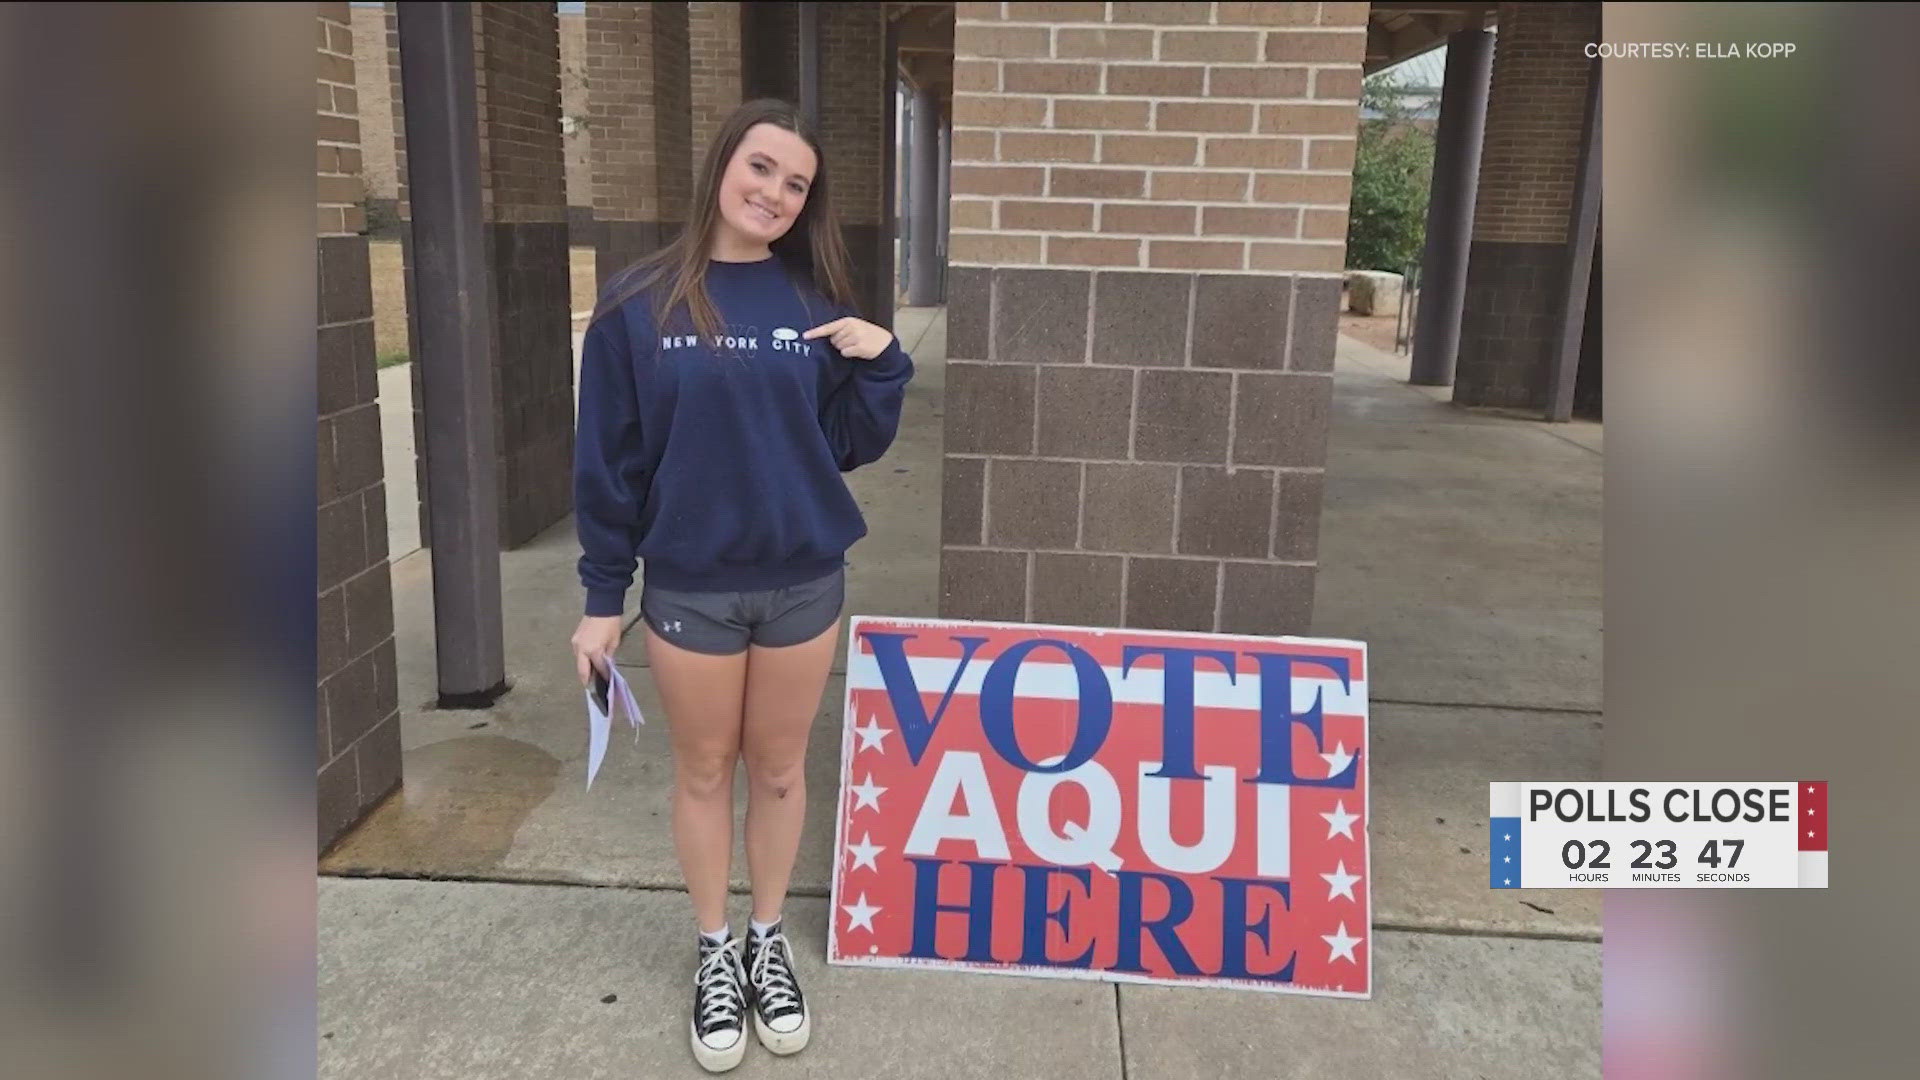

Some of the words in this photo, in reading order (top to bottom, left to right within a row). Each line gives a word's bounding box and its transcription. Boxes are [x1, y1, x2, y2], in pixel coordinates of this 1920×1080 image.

[662, 335, 698, 351] NEW
[714, 335, 759, 350] YORK
[772, 339, 811, 357] CITY
[859, 631, 1361, 789] VOTE
[903, 751, 1290, 878] AQUI
[898, 857, 1297, 983] HERE
